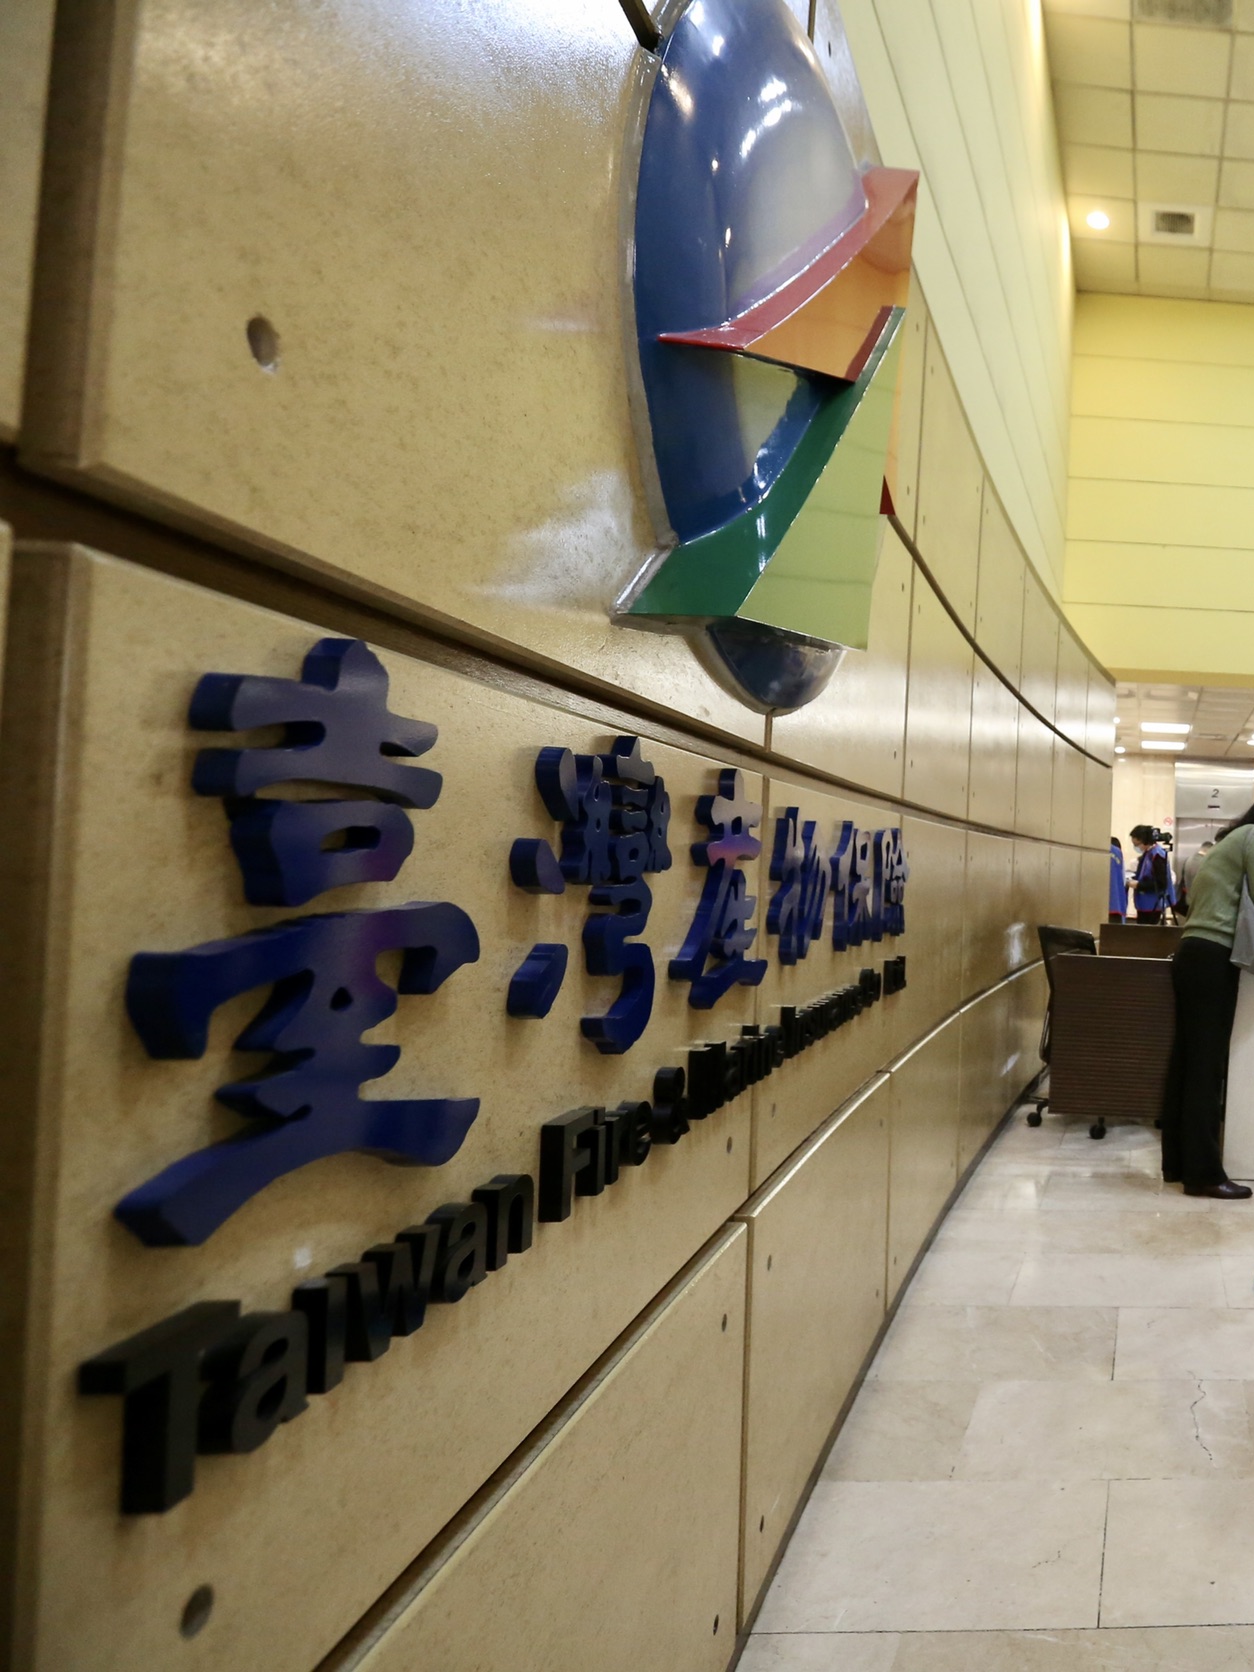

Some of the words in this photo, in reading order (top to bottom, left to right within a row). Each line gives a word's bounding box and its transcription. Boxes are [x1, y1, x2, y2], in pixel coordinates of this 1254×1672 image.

[1211, 788, 1220, 799] 2
[78, 1173, 534, 1515] Taiwan
[538, 1106, 652, 1223] Fire
